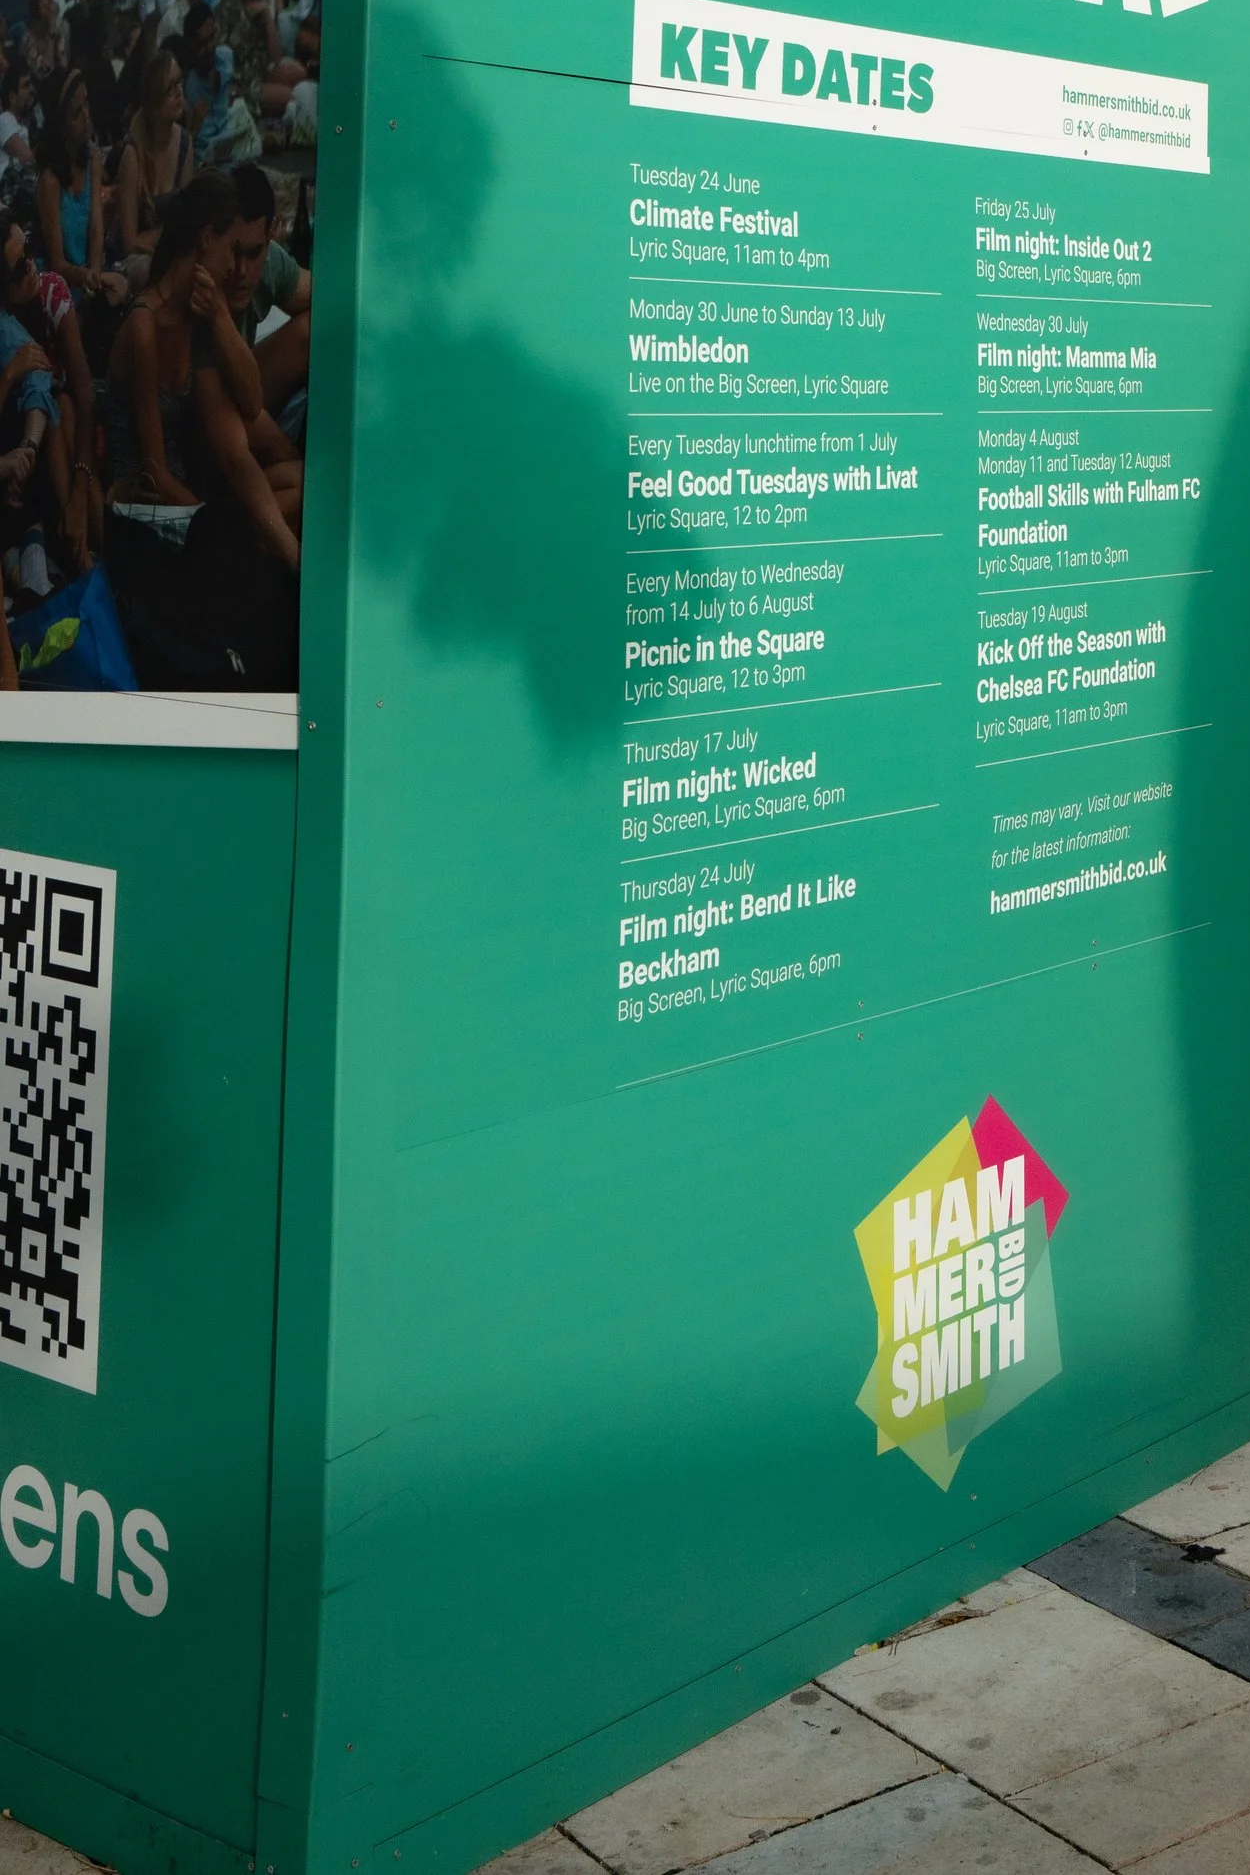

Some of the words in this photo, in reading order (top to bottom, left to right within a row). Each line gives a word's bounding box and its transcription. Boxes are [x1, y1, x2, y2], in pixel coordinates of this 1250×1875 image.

[660, 22, 771, 93] KEY
[780, 40, 935, 113] DATES
[1062, 84, 1192, 121] hammersmithbid.co.uk
[1098, 122, 1191, 148] @hammersmithbid
[630, 163, 696, 194] Tuesday
[700, 170, 720, 190] 24
[723, 173, 760, 195] June
[630, 198, 714, 231] Climate
[720, 206, 798, 237] Festival
[975, 197, 1012, 222] Friday
[1014, 200, 1030, 219] 25
[1032, 203, 1056, 225] July
[630, 236, 668, 262] Lyric
[672, 239, 729, 265] Square,
[734, 244, 775, 265] 11am
[779, 248, 794, 266] to
[797, 248, 830, 272] 4pm
[976, 227, 1011, 252] Film
[1015, 230, 1060, 260] night:
[1064, 234, 1110, 259] Inside
[1113, 238, 1139, 261] Out
[1142, 240, 1152, 262] 2
[630, 298, 694, 326] Monday
[698, 301, 717, 322] 30
[721, 302, 759, 323] June
[761, 305, 777, 324] to
[780, 304, 833, 331] Sunday
[837, 307, 854, 327] 13
[858, 308, 886, 332] July
[629, 334, 749, 363] Wimbledon
[978, 342, 1013, 367] Film
[1017, 344, 1062, 373] night:
[1066, 345, 1126, 368] Mamma
[1130, 347, 1156, 369] Mia
[629, 435, 672, 461] Every
[675, 433, 741, 459] Tuesday
[745, 433, 817, 454] lunchtime
[820, 432, 854, 452] from
[858, 432, 864, 451] 1
[869, 432, 897, 456] July
[978, 428, 1026, 451] Monday
[1029, 429, 1037, 446] 4
[1039, 429, 1079, 450] August
[628, 469, 673, 498] Feel
[678, 468, 732, 497] Good
[736, 466, 829, 499] Tuesdays
[833, 465, 871, 491] with
[876, 464, 918, 490] Livat
[978, 455, 1027, 478] Monday
[1030, 455, 1042, 473] 11
[1047, 454, 1068, 472] and
[1070, 453, 1117, 474] Tuesday
[1119, 452, 1132, 469] 12
[1134, 452, 1171, 473] August
[978, 484, 1043, 511] Football
[1047, 482, 1089, 507] Skills
[1093, 481, 1124, 504] with
[1128, 479, 1179, 503] Fulham
[1182, 477, 1200, 499] FC
[978, 519, 1068, 547] Foundation
[627, 573, 671, 597] Every
[675, 566, 738, 592] Monday
[741, 567, 757, 586] to
[760, 559, 844, 584] Wednesday
[625, 604, 665, 625] from
[670, 600, 690, 621] 14
[693, 597, 727, 624] July
[729, 598, 745, 617] to
[749, 595, 759, 615] 6
[762, 592, 814, 618] August
[977, 607, 1028, 629] Tuesday
[1031, 605, 1046, 623] 19
[1048, 602, 1088, 624] August
[625, 637, 691, 669] Picnic
[696, 635, 715, 662] in
[719, 631, 752, 659] the
[757, 629, 825, 660] Square
[977, 638, 1014, 666] Kick
[1018, 634, 1044, 661] Off
[1047, 632, 1073, 657] the
[1077, 630, 1132, 653] Season
[1136, 620, 1166, 645] with
[977, 674, 1043, 703] Chelsea
[1047, 668, 1068, 693] FC
[1072, 658, 1155, 690] Foundation
[623, 736, 699, 765] Thursday
[704, 731, 723, 753] 17
[726, 727, 758, 753] July
[623, 776, 670, 807] Film
[677, 766, 737, 803] night:
[743, 751, 816, 788] Wicked
[992, 813, 1028, 833] Times
[1030, 808, 1056, 827] may
[1058, 803, 1083, 821] vary.
[1088, 793, 1111, 813] Visit
[1112, 792, 1131, 808] our
[1133, 782, 1173, 804] website
[991, 850, 1009, 869] for
[1011, 846, 1030, 865] the
[1032, 837, 1064, 860] latest
[1066, 825, 1131, 852] information:
[620, 872, 696, 903] Thursday
[700, 865, 720, 888] 24
[723, 859, 755, 885] July
[990, 850, 1167, 915] hammersmithbid.co.uk
[620, 914, 667, 946] Film
[674, 900, 734, 937] night:
[740, 884, 792, 921] Bend
[797, 883, 811, 908] It
[816, 874, 856, 904] Like
[619, 947, 720, 990] Beckham
[893, 1154, 1025, 1275] HAM
[998, 1227, 1025, 1304] BID
[893, 1241, 997, 1343] MER
[891, 1302, 1025, 1419] SMITH
